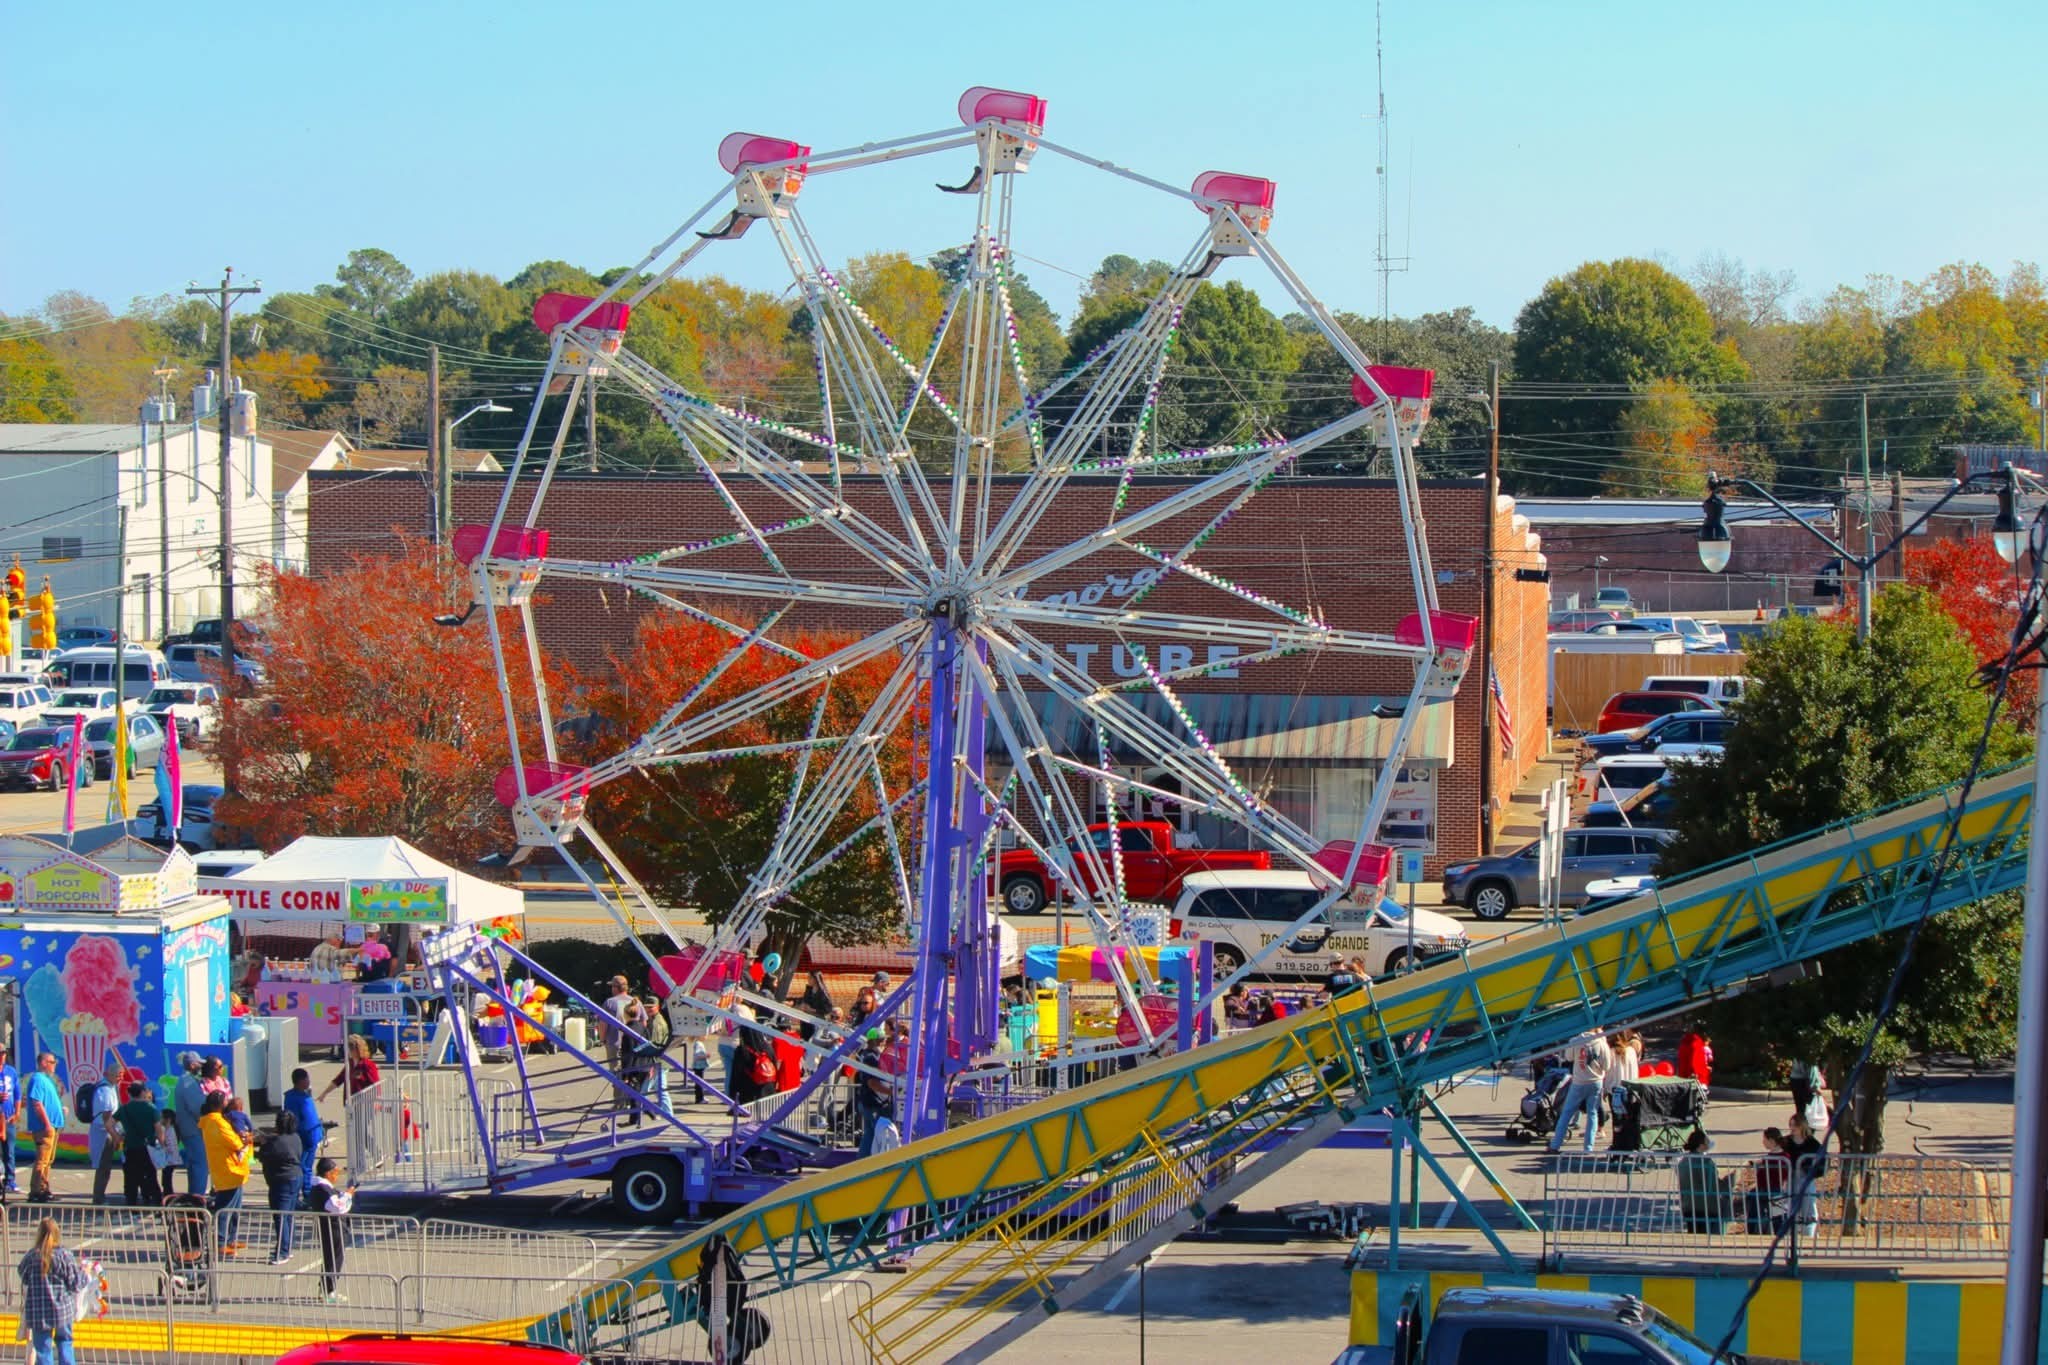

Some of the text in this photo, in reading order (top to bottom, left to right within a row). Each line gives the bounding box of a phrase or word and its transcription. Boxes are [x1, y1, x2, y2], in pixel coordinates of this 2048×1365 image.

[51, 879, 81, 887] HOT
[36, 890, 99, 901] POPCORN
[281, 890, 340, 910] CORN
[1137, 928, 1149, 936] OF
[1328, 935, 1369, 951] GRANDE
[364, 999, 400, 1013] ENTER
